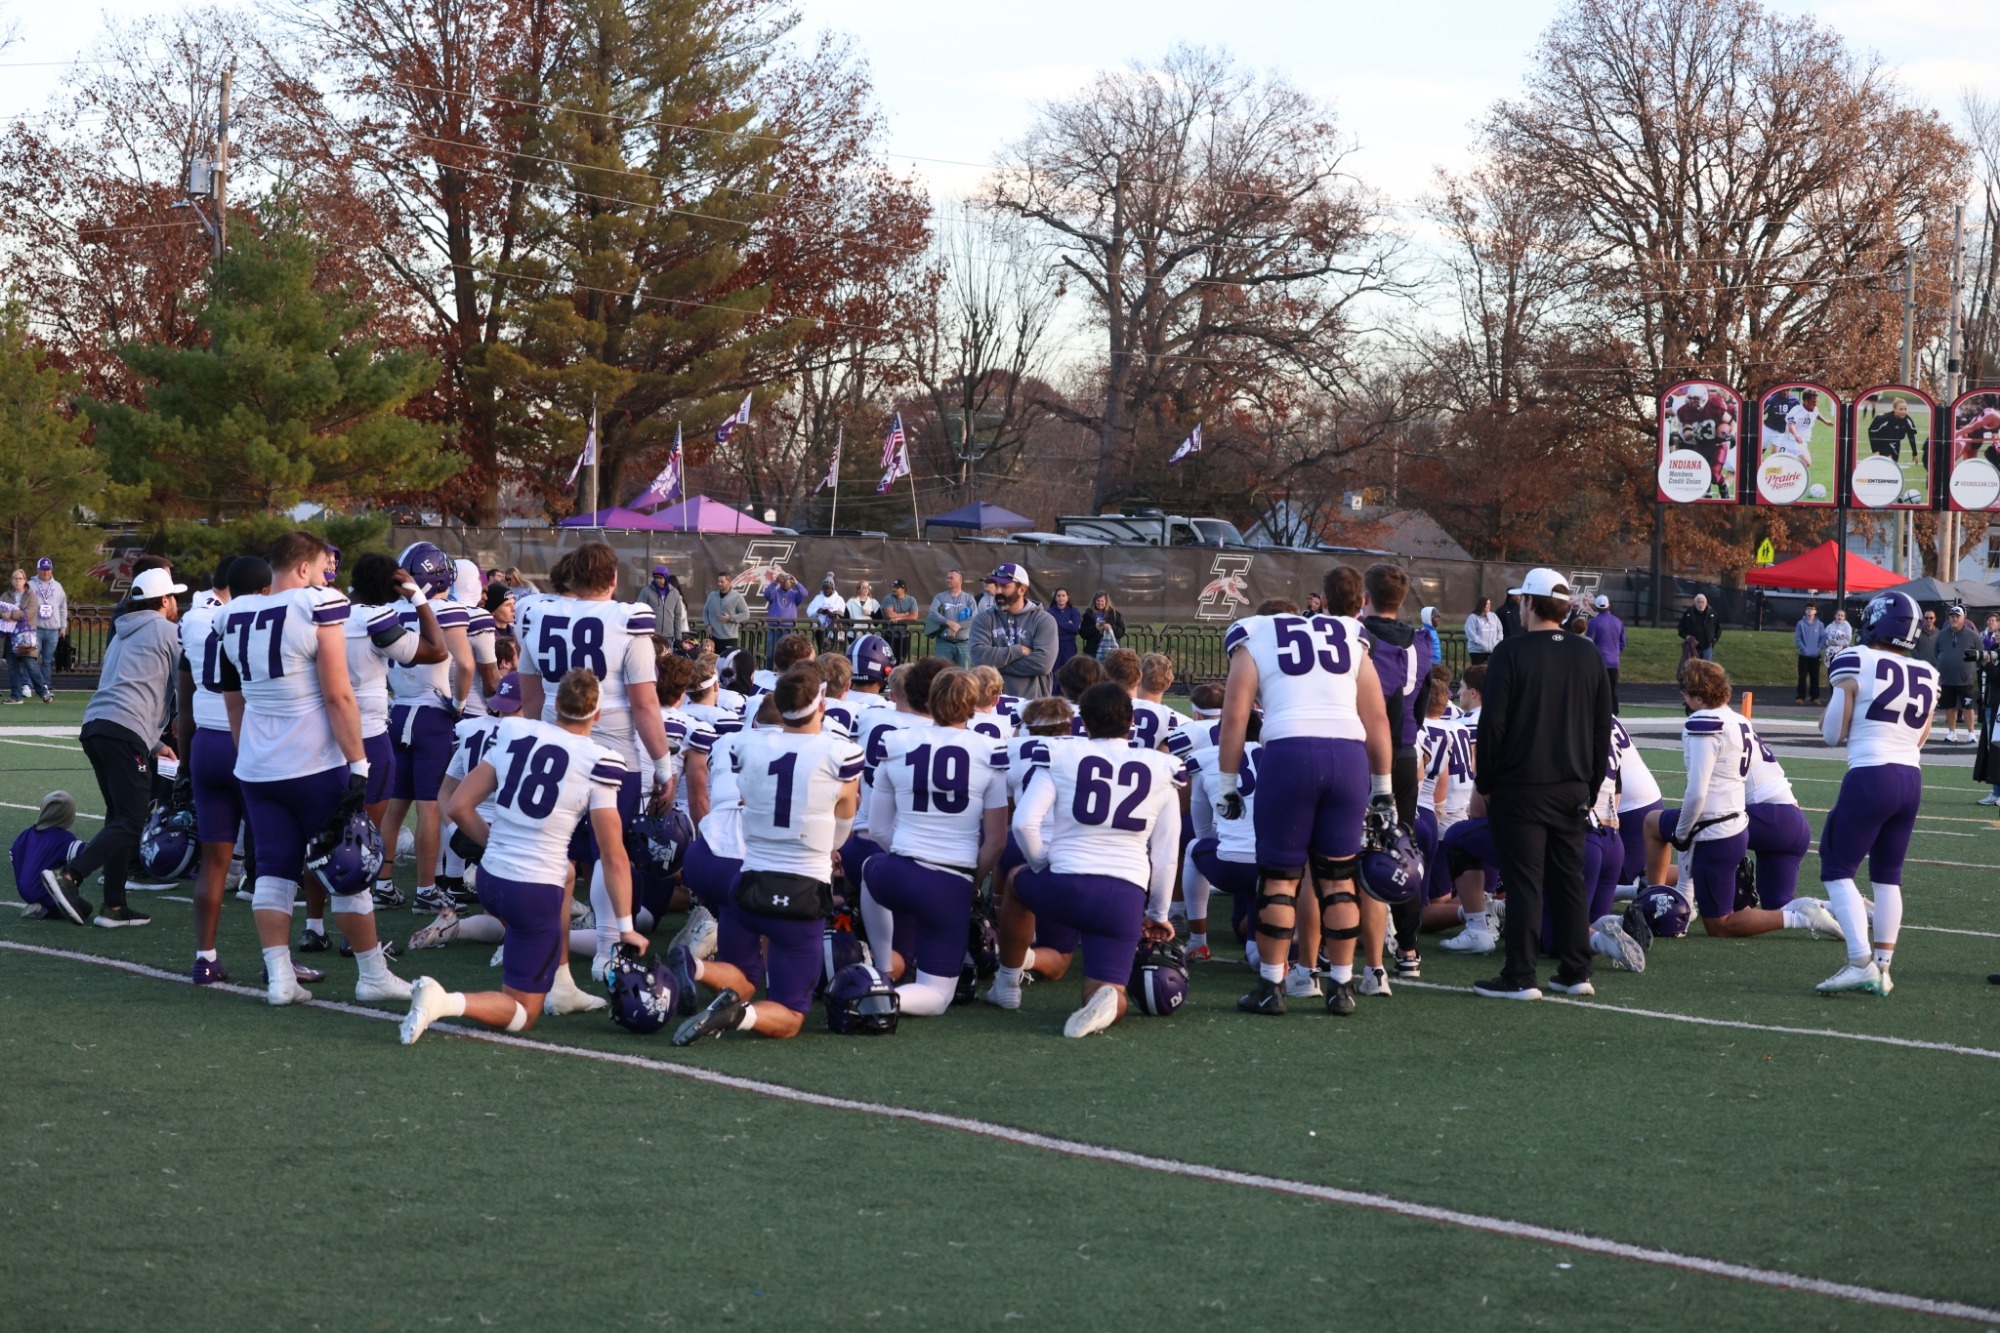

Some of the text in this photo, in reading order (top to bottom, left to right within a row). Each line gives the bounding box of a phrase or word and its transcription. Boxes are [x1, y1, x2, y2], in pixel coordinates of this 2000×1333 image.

[1669, 460, 1702, 470] INDIANA
[1766, 471, 1802, 485] Prairie
[1771, 482, 1795, 490] Farms
[421, 559, 434, 572] 15
[227, 605, 288, 681] 77
[538, 614, 607, 683] 58
[882, 646, 891, 657] 45
[1273, 617, 1351, 676] 53
[1865, 659, 1933, 729] 25
[497, 735, 569, 819] 18
[768, 752, 798, 828] 1
[906, 744, 970, 813] 19
[1073, 755, 1152, 832] 62
[1391, 868, 1409, 886] 53
